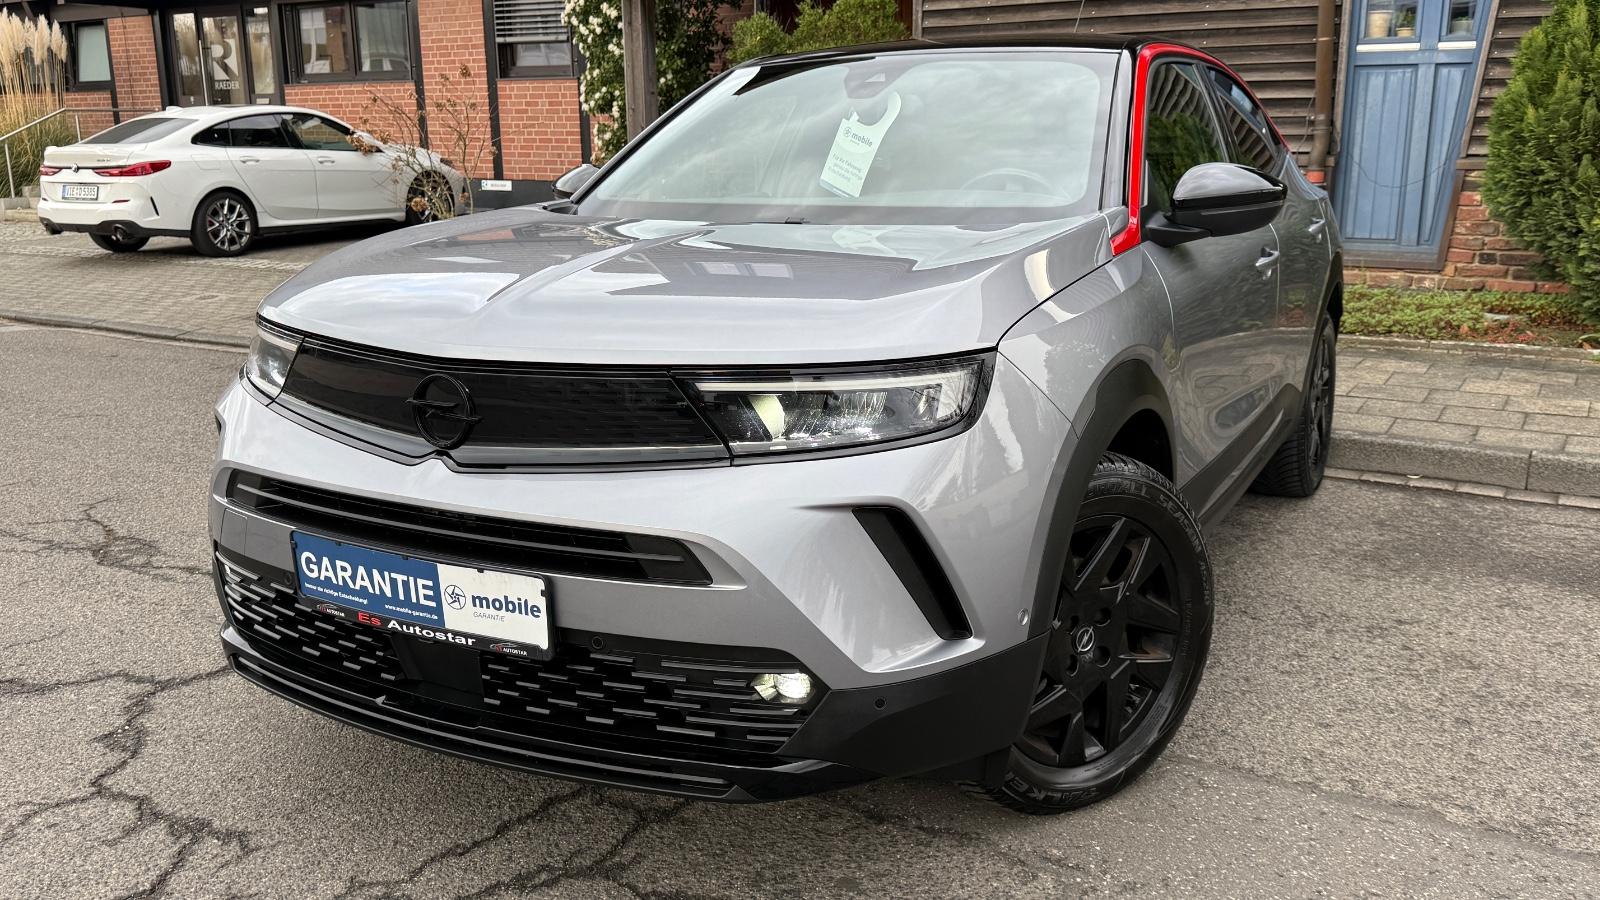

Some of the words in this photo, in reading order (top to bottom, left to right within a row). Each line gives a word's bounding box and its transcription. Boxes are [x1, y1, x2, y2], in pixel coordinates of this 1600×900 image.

[214, 81, 240, 89] RAEDER
[852, 133, 872, 147] mobile
[1158, 494, 1202, 553] SEASON
[300, 551, 437, 607] GARANTIE
[323, 588, 338, 597] richtige
[338, 591, 368, 605] Entscheidung!
[384, 603, 438, 620] www.mobile-garantie.de
[471, 594, 542, 619] mobile
[473, 611, 505, 622] GARANTIE
[357, 611, 382, 626] Es
[387, 619, 476, 646] Autostar
[502, 647, 528, 656] AUTOSTAR
